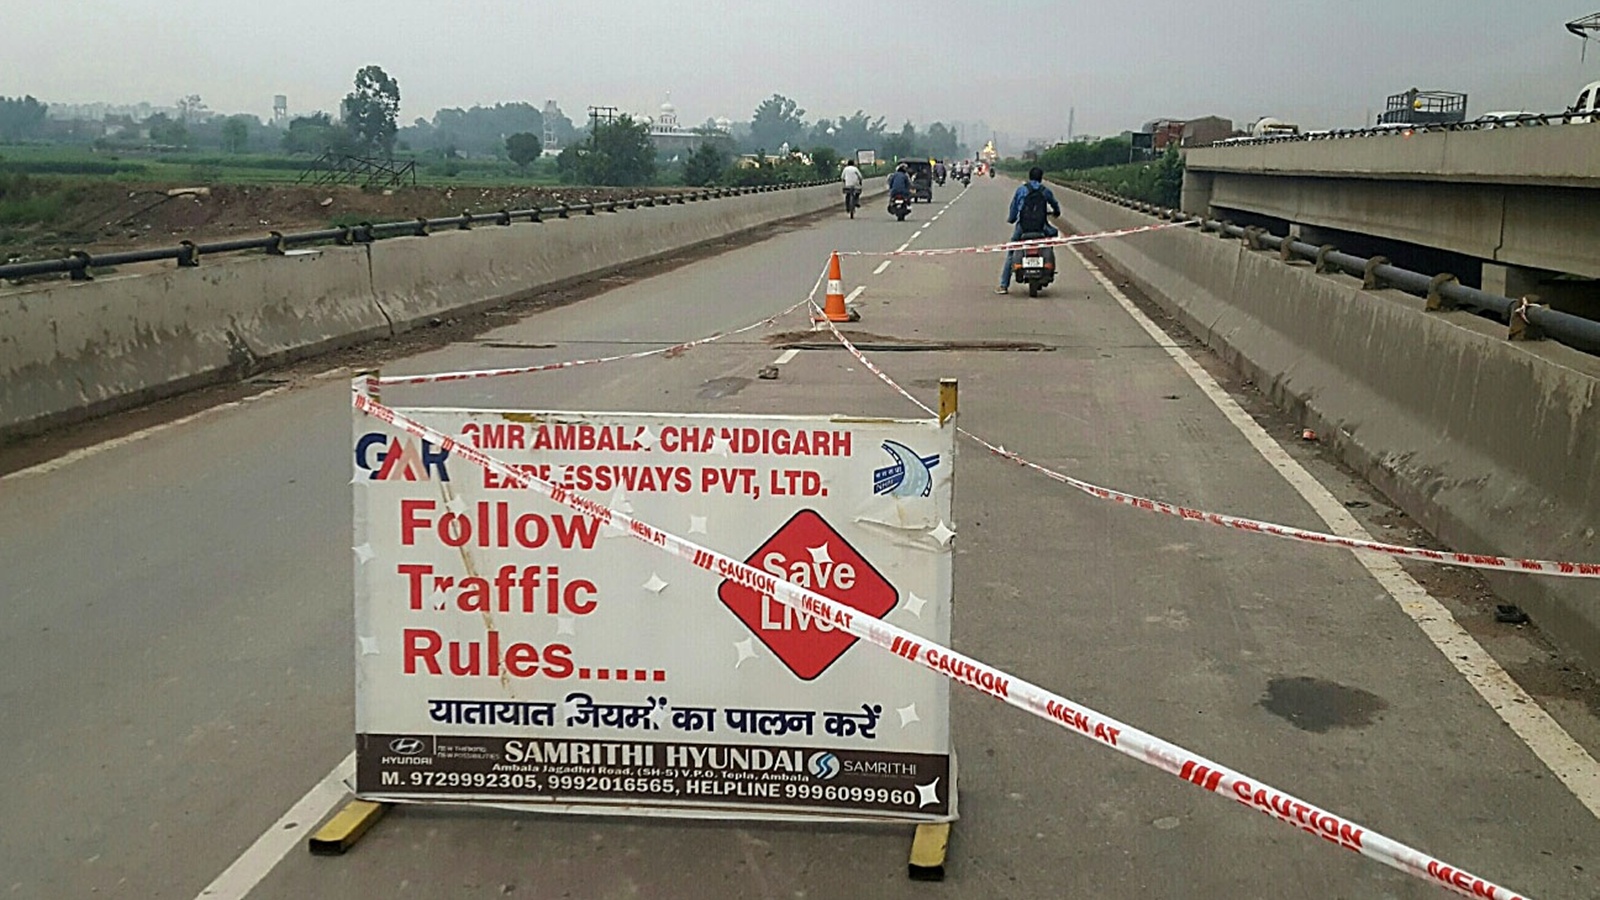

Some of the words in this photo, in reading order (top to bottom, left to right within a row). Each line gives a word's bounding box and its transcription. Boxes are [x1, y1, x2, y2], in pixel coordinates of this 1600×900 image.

[660, 426, 851, 456] CHANDIGARH
[771, 470, 827, 496] LTD.
[401, 500, 600, 549] Follow
[718, 559, 776, 594] CAUTION
[762, 551, 856, 590] Save
[397, 564, 598, 614] Traffic
[801, 594, 831, 619] MEN
[834, 610, 853, 628] AT
[926, 649, 1008, 697] CAUTION
[428, 700, 556, 726] यातायात
[671, 707, 715, 731] का
[725, 709, 815, 735] पालन
[823, 704, 882, 738] करें
[1046, 700, 1089, 732] MEN
[1093, 723, 1121, 746] AT
[381, 756, 432, 765] HYUNDAI
[492, 763, 539, 772] Ambala
[761, 773, 809, 782] Ambala
[504, 741, 654, 766] SAMRITHI
[666, 746, 803, 772] HYUNDAI
[843, 760, 917, 775] SAMRITHI
[381, 772, 406, 786] M.
[686, 780, 781, 798] HELPLINE
[785, 784, 916, 805] 9996099960
[1232, 780, 1363, 849] CAUTION
[1427, 861, 1496, 900] MEN
